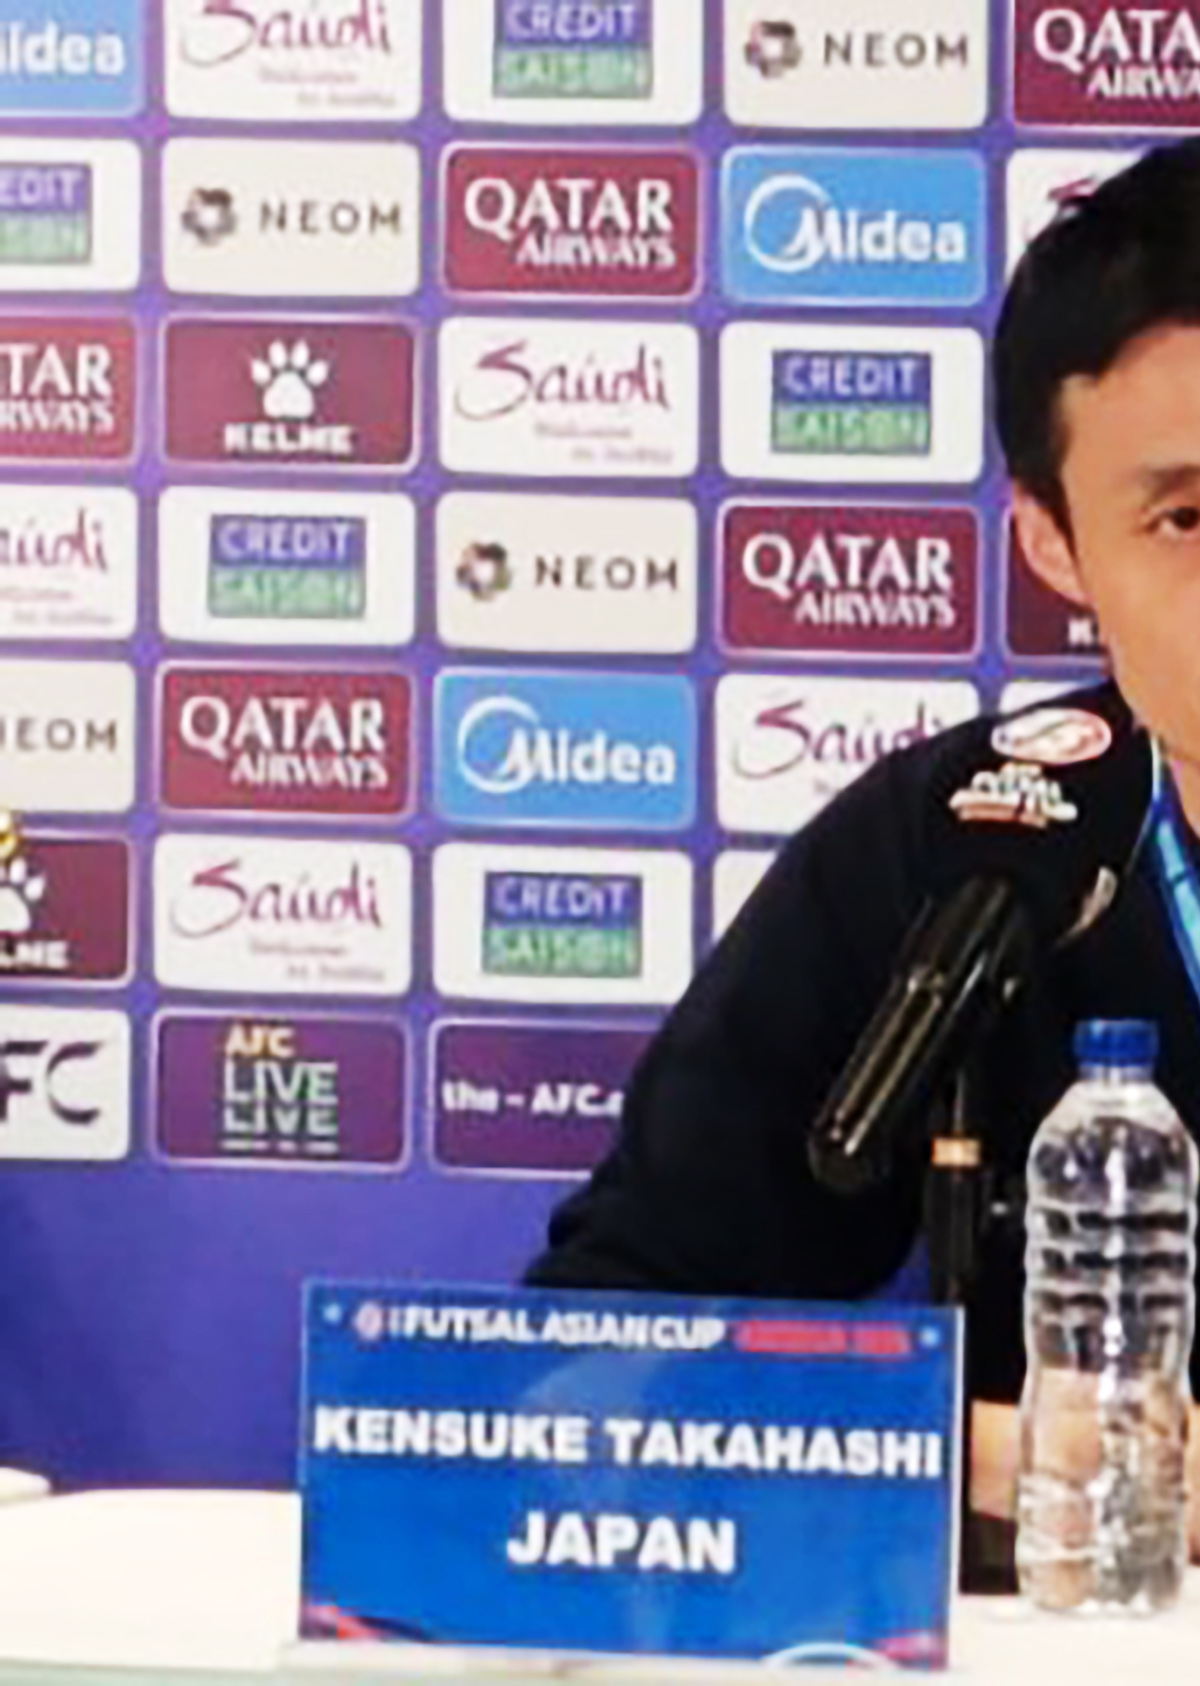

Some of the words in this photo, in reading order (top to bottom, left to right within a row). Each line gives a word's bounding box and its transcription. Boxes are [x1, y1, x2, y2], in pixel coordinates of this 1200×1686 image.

[507, 3, 637, 39] CREDIT
[0, 21, 125, 65] idea
[823, 32, 968, 65] NEOM
[259, 200, 402, 235] NEOM
[463, 178, 673, 240] QATAR
[516, 231, 676, 268] AIRWAYS
[780, 206, 968, 263] Midea
[785, 357, 918, 395] CREDIT
[224, 425, 354, 455] KELME
[217, 522, 352, 557] CREDIT
[534, 555, 679, 592] NEOM
[742, 533, 952, 598] QATAR
[797, 592, 955, 628] AIRWAYS
[0, 717, 118, 753] EOM
[180, 696, 386, 761] QATAR
[230, 750, 388, 790] AIRWAYS
[502, 728, 678, 785] Midea
[492, 877, 630, 916] CREDIT
[224, 1026, 295, 1057] AFC
[223, 1062, 339, 1104] LIVE
[403, 1305, 534, 1343] FUTSAL
[541, 1307, 648, 1347] ASIAN
[652, 1314, 726, 1350] CUP
[314, 1405, 588, 1463] KENSUKE
[605, 1417, 943, 1479] TAKAHASHI
[506, 1511, 736, 1574] JAPAN
